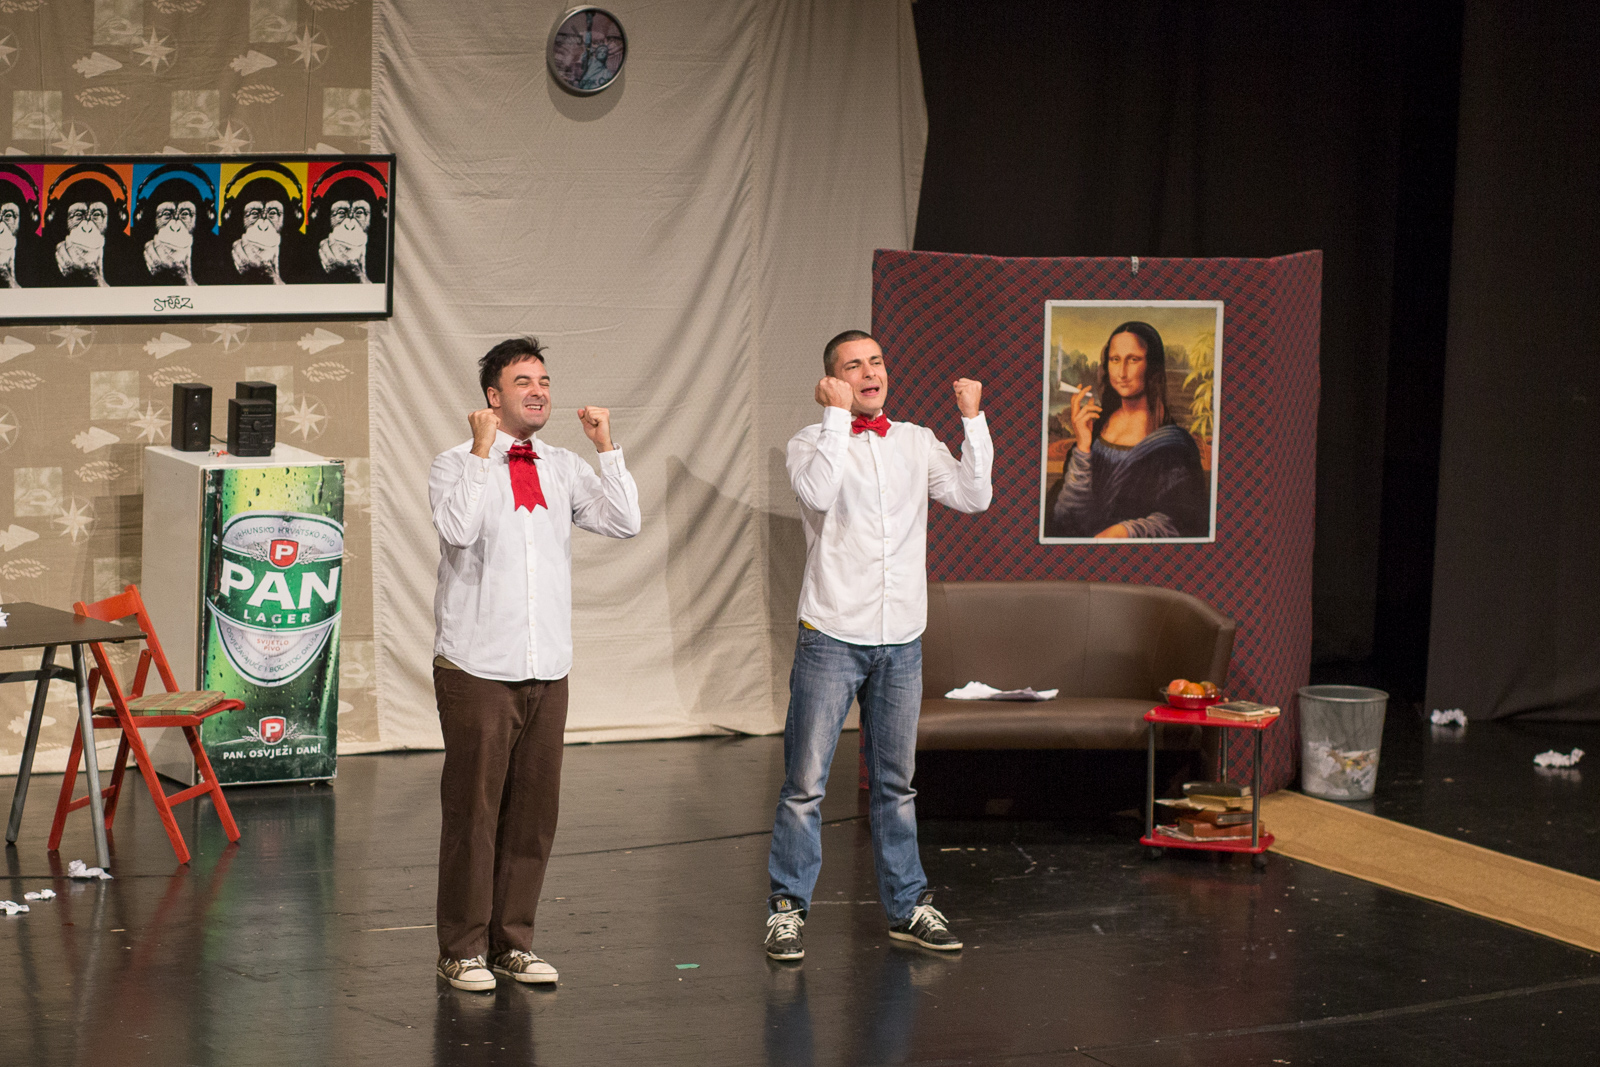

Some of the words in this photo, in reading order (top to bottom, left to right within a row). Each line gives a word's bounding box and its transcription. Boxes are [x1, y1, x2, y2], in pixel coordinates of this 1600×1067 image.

[278, 526, 321, 539] HRVATSKO
[321, 534, 335, 547] PIVO
[274, 544, 294, 560] P
[220, 558, 341, 610] PAN
[243, 609, 311, 624] LAGER
[256, 638, 289, 647] SVIJETLO
[301, 633, 320, 656] OKUSA
[265, 722, 281, 738] P
[223, 751, 247, 760] PAN.
[249, 745, 293, 759] OSVJEŽI
[296, 743, 321, 755] DAN!
